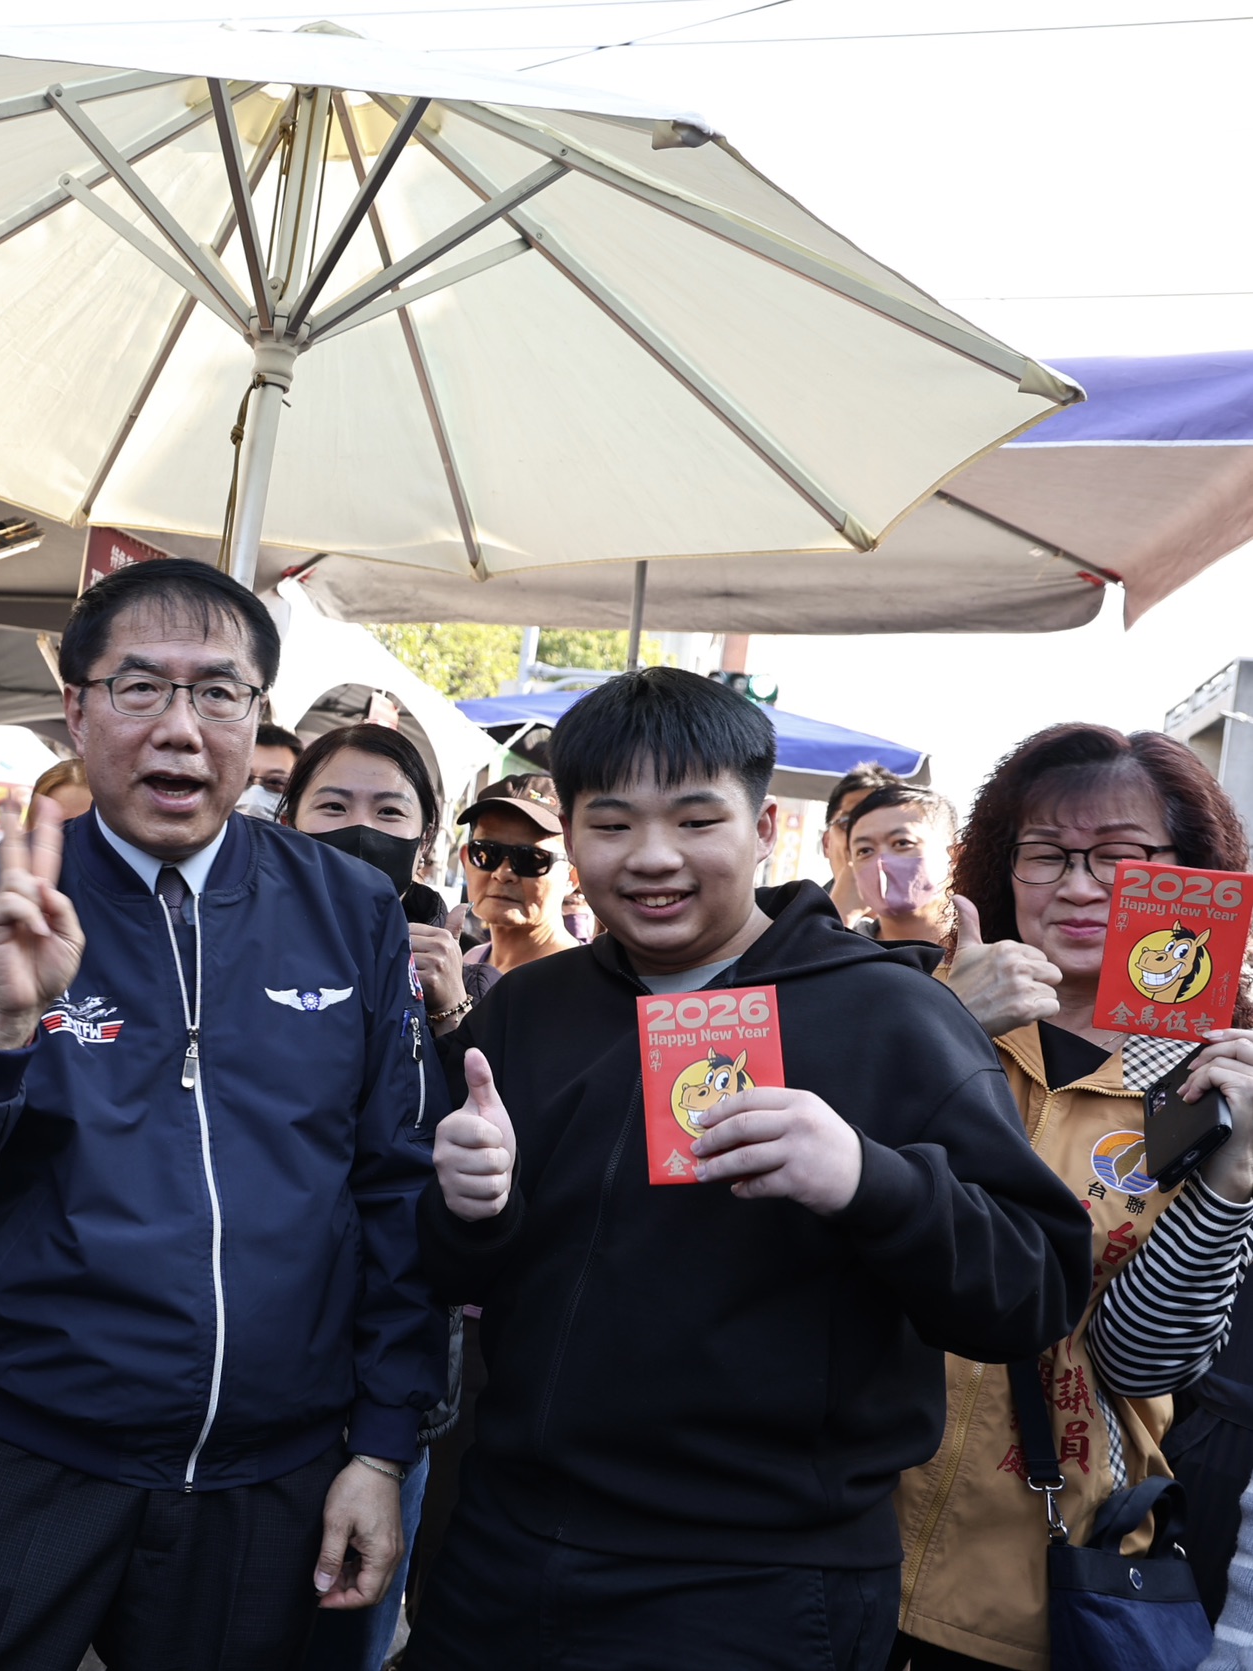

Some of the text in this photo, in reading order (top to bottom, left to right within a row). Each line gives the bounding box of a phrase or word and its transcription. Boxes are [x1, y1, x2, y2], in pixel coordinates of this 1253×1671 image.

[1120, 869, 1243, 908] 2026
[1119, 897, 1238, 922] Happy New Year
[646, 992, 771, 1032] 2026
[1108, 1001, 1216, 1037] 金馬伍吉
[648, 1025, 770, 1048] Happy New Year
